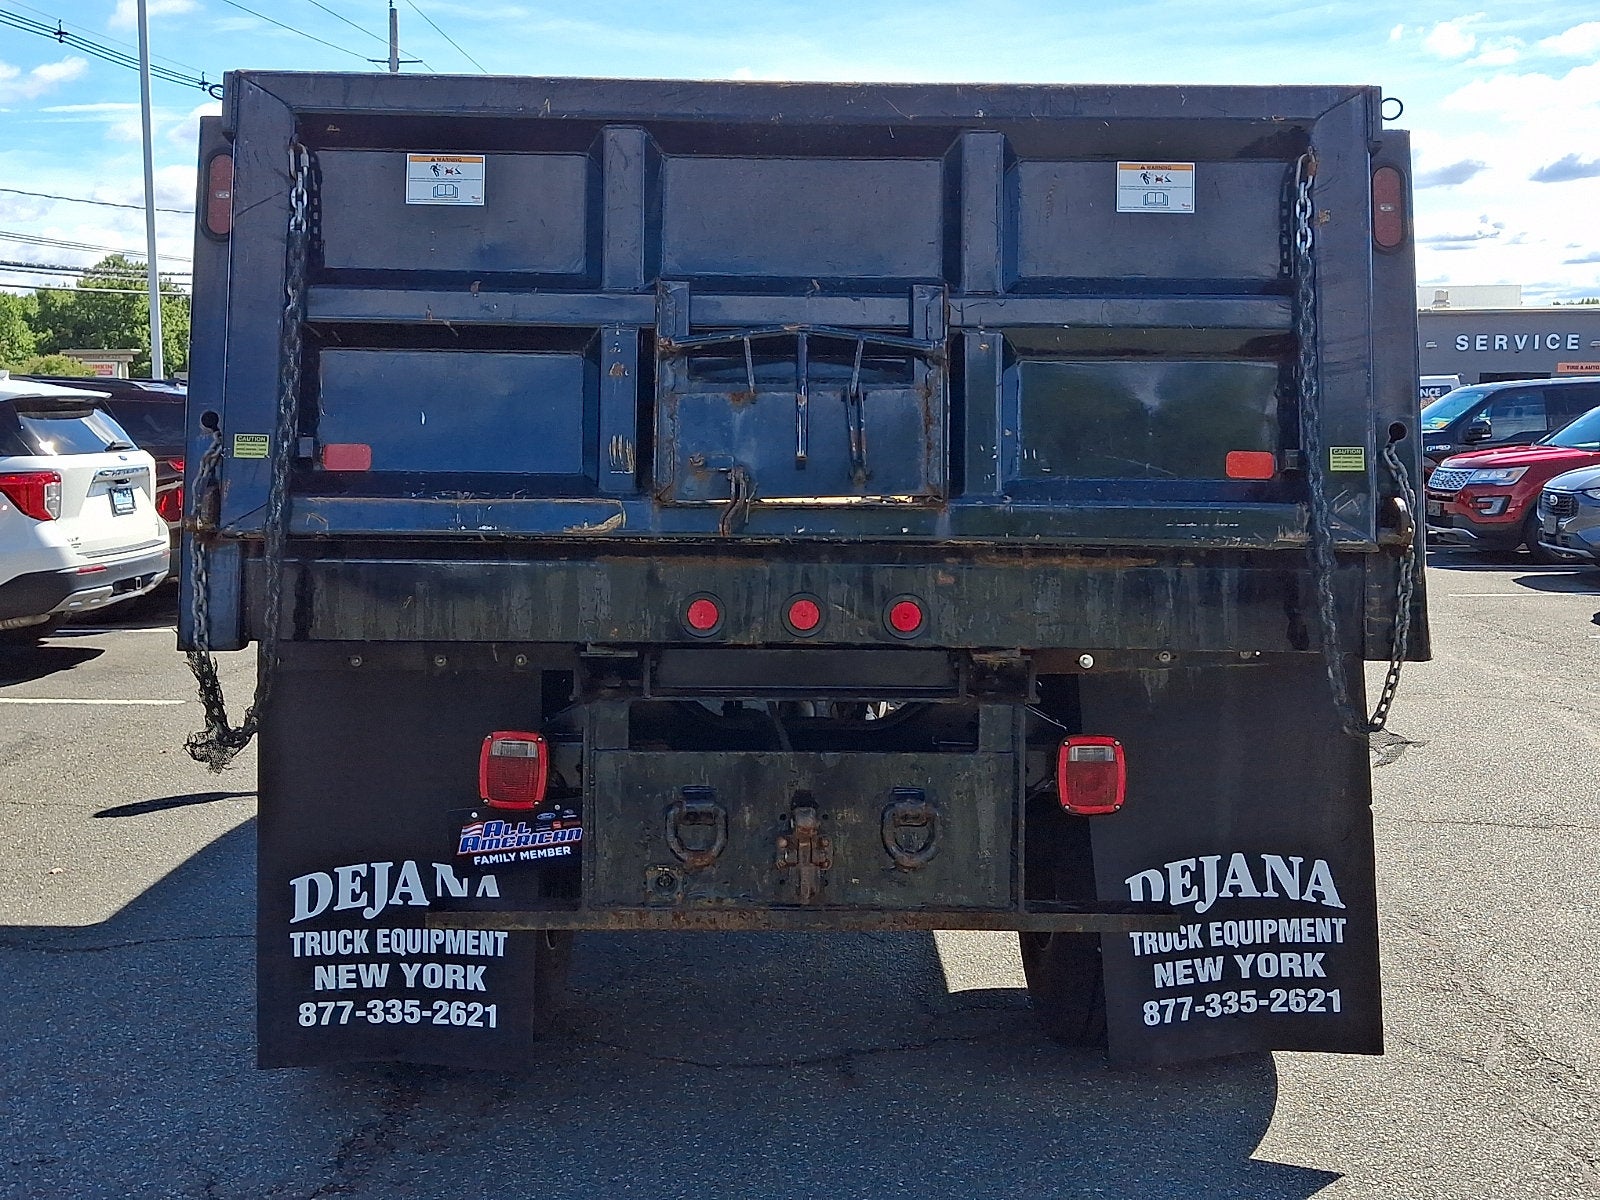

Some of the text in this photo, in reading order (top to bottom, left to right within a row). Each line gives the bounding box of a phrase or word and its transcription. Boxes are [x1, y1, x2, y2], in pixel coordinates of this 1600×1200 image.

[1455, 333, 1580, 351] SERVICE
[473, 845, 572, 866] FAMILY MEMBER
[1124, 853, 1346, 914] DEJANA
[289, 928, 509, 958] TRUCK EQUIPMENT
[1129, 917, 1347, 957] TRUCK EQUIPMENT
[314, 963, 487, 992] NEW YORK
[1153, 952, 1328, 989] NEW YORK
[298, 999, 498, 1029] 877-335-2621
[1142, 988, 1342, 1027] 877-335-2621
